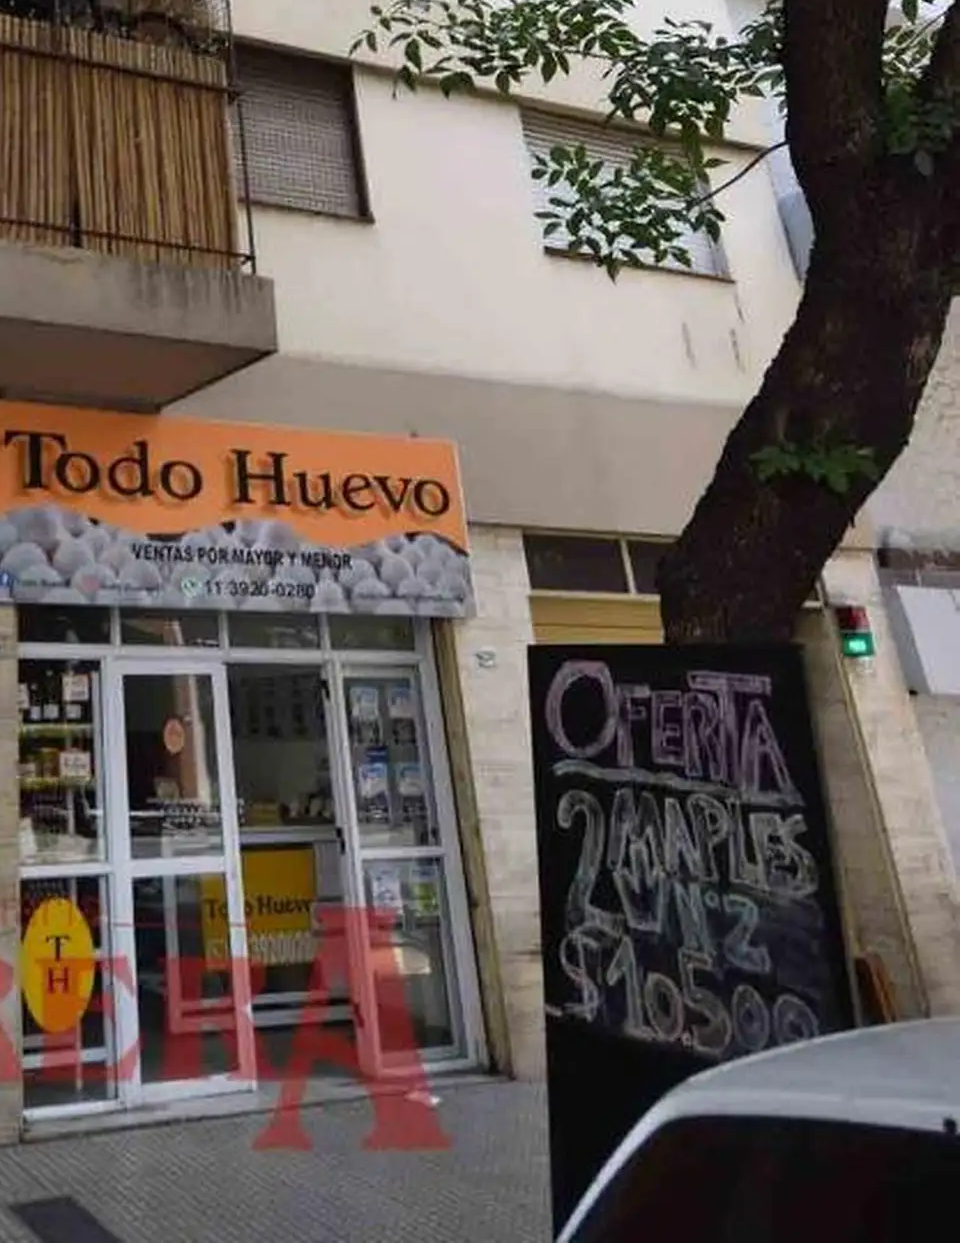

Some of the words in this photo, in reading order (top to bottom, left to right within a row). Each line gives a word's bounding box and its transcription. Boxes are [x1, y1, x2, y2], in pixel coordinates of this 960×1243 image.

[4, 430, 203, 501] Todo
[230, 448, 451, 517] Huevo
[132, 543, 194, 562] VENTAS
[197, 546, 228, 564] POR
[232, 548, 284, 566] MAYOR
[286, 550, 297, 566] Y
[301, 551, 353, 571] MENOR
[545, 660, 806, 807] OFERTA
[45, 934, 70, 962] T
[48, 967, 69, 994] H
